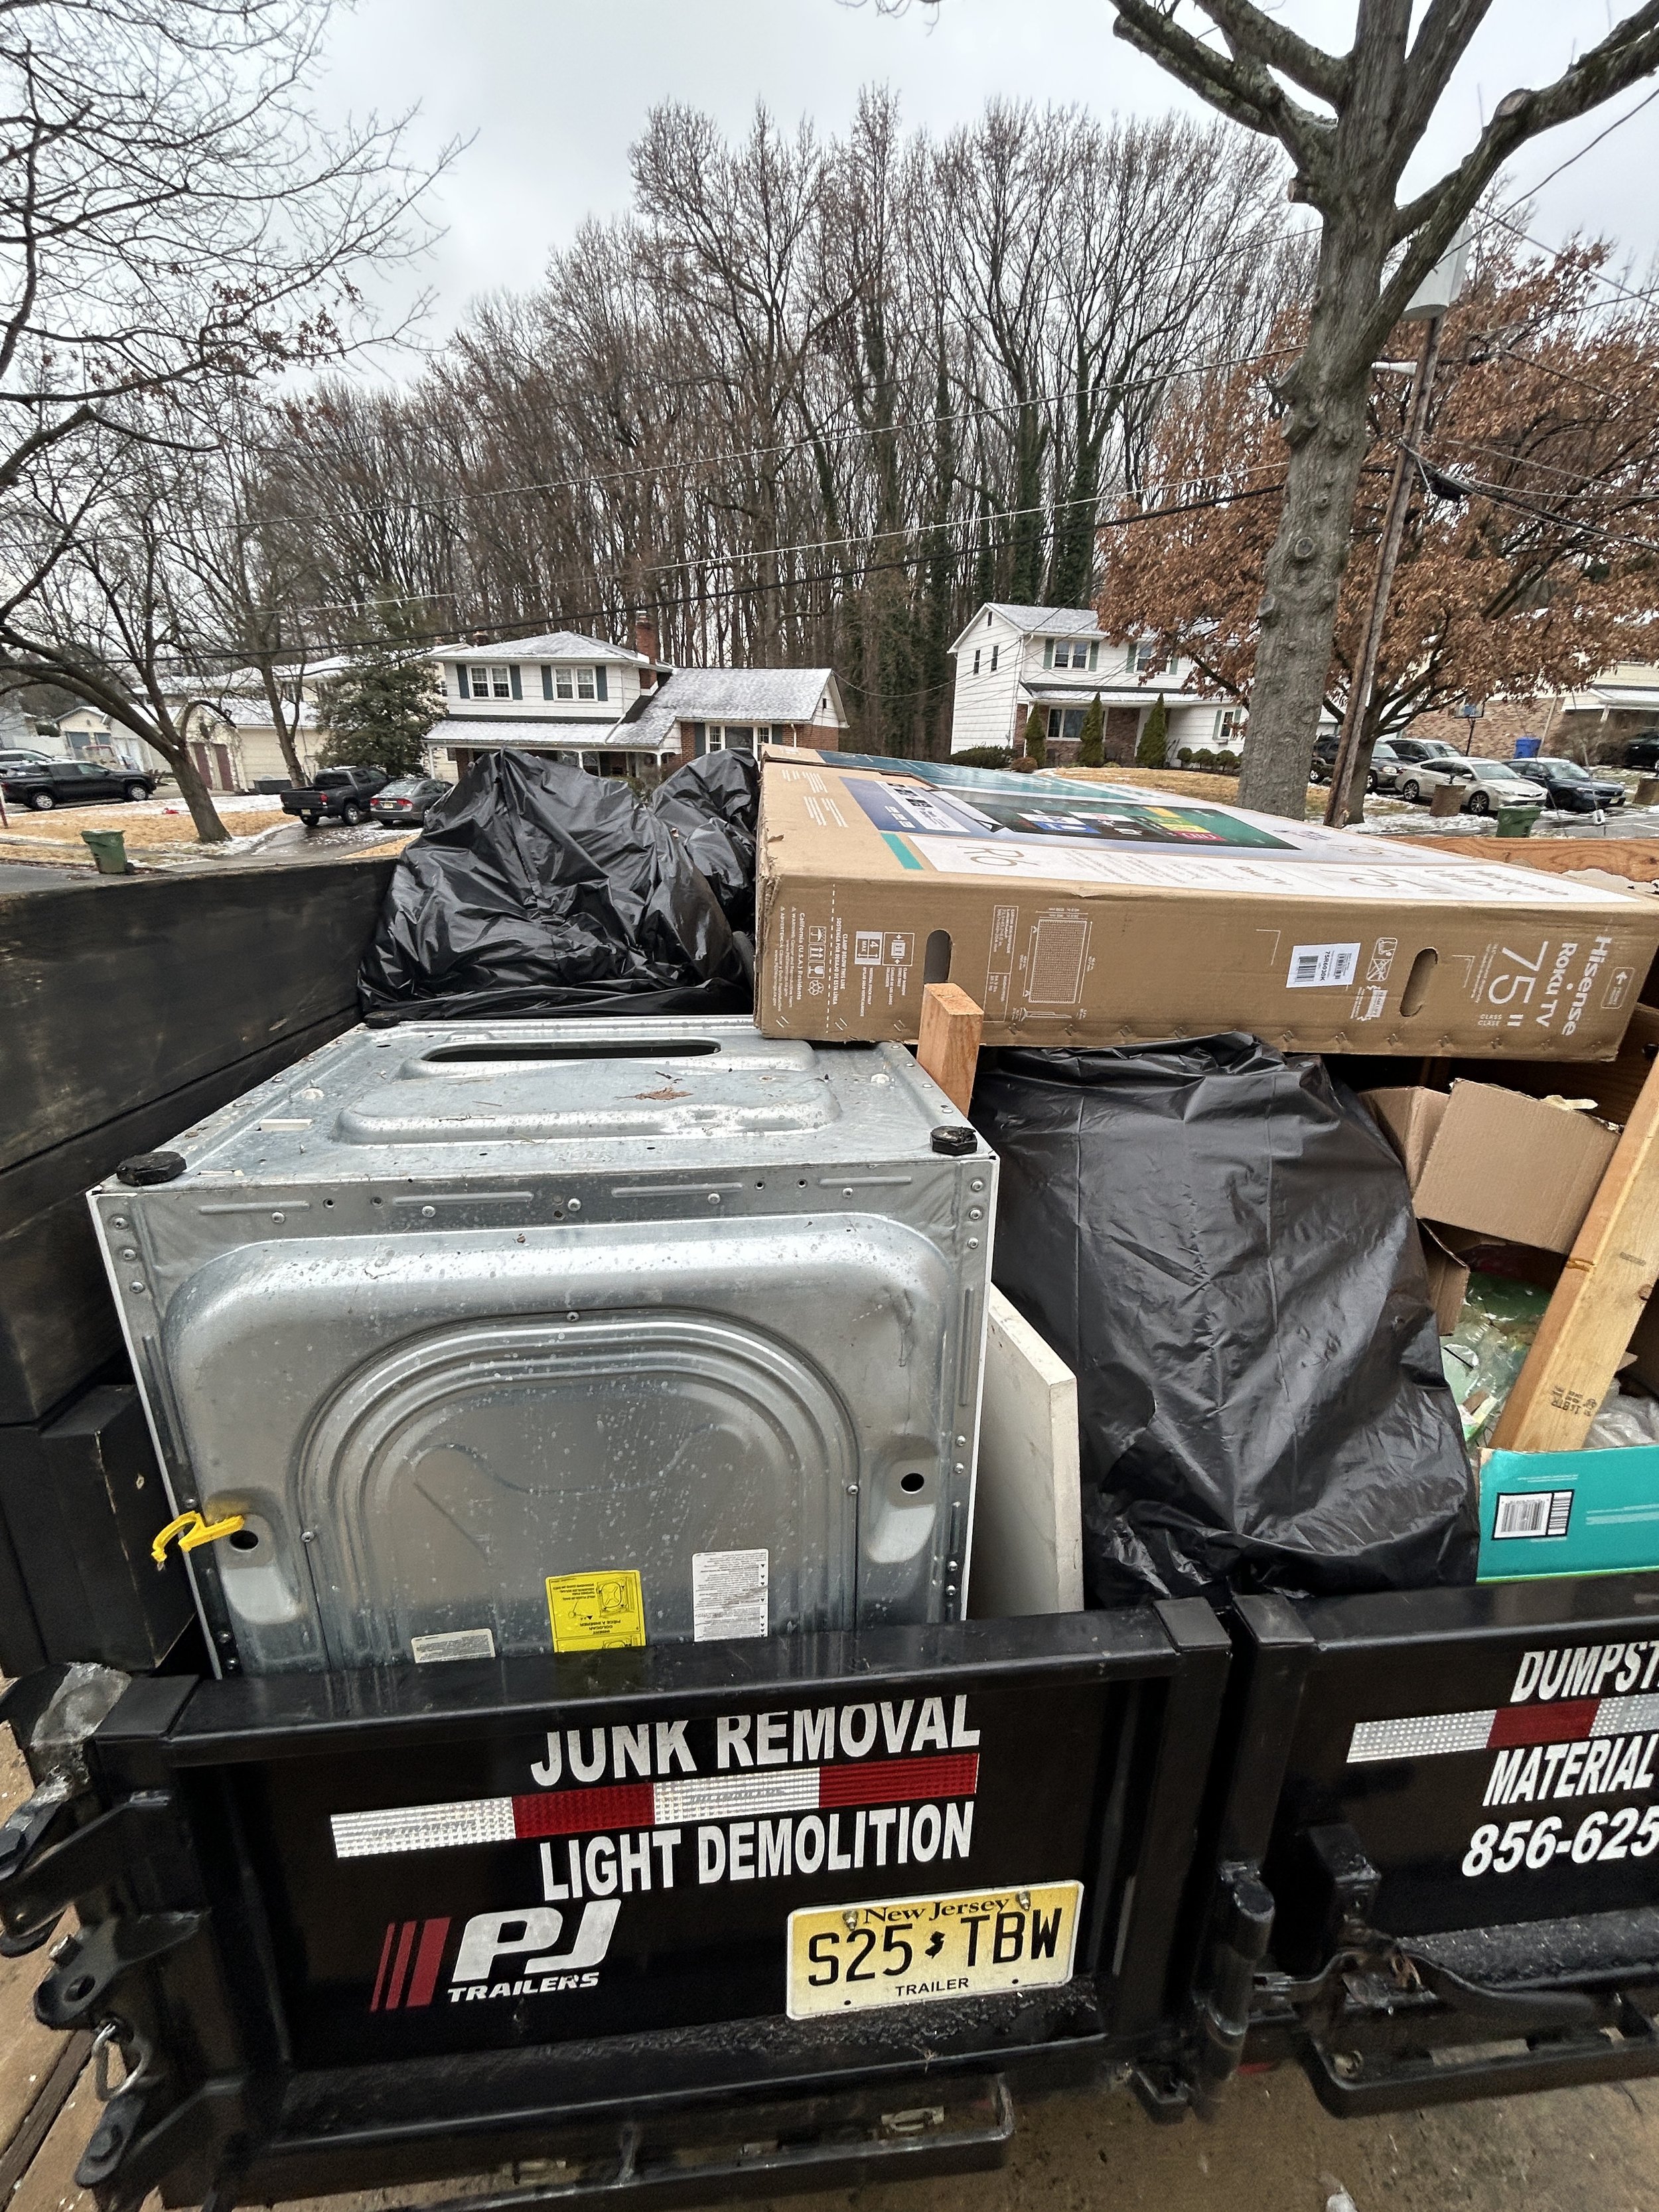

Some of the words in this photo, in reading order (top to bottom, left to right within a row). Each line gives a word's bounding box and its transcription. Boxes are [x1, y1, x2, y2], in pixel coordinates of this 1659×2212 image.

[1320, 951, 1331, 981] 75R6030K
[1545, 942, 1578, 995] Roku
[1561, 936, 1612, 1036] Hisense
[1535, 999, 1558, 1027] TV
[530, 1720, 697, 1787] JUNK
[717, 1694, 980, 1769] REMOVAL
[1482, 1733, 1659, 1806] MATERIAL
[540, 1830, 682, 1901] LIGHT
[698, 1801, 974, 1884] DEMOLITION
[452, 1899, 621, 1982] PJ
[865, 1907, 926, 1924] New
[929, 1898, 1009, 1921] Jersey
[808, 1923, 913, 1986] S25
[960, 1907, 1063, 1966] TBW
[447, 1972, 599, 2003] TRAILERS
[896, 1977, 969, 1996] TRAILER
